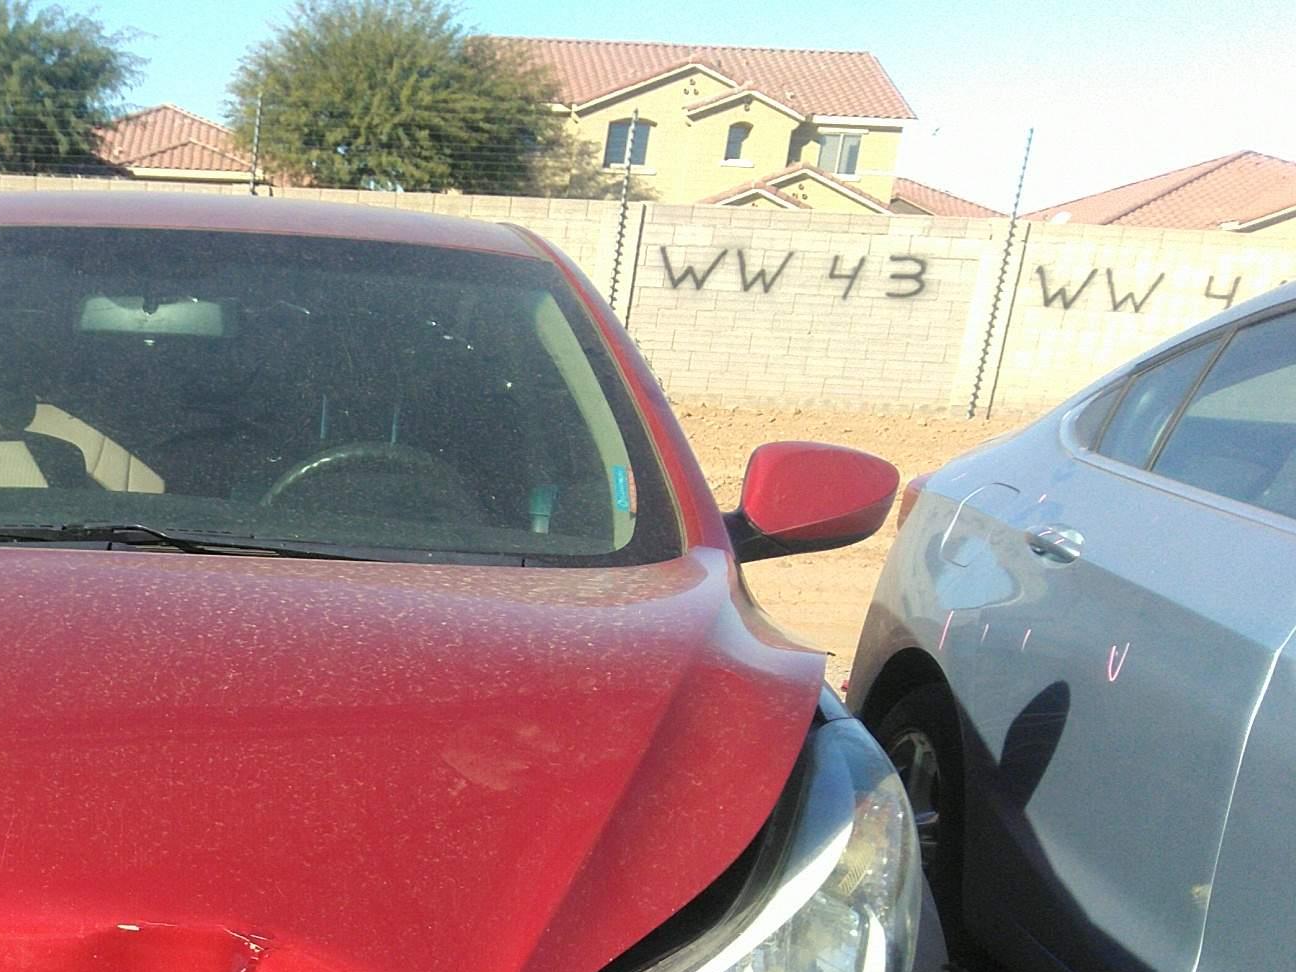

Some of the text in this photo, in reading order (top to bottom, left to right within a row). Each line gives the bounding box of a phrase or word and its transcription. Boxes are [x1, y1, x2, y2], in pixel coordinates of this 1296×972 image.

[660, 246, 927, 301] WW 43
[1036, 265, 1165, 313] WW
